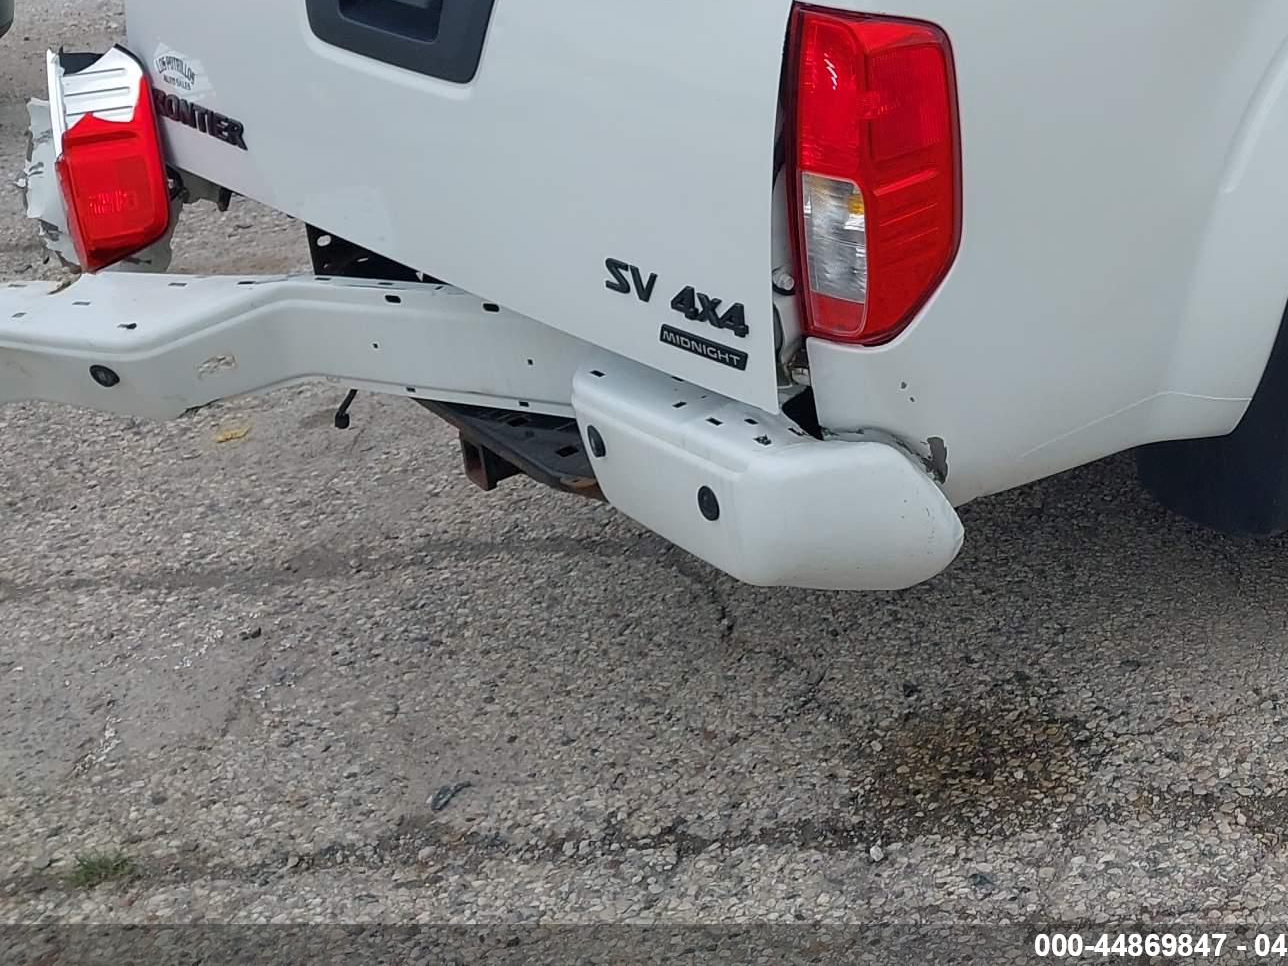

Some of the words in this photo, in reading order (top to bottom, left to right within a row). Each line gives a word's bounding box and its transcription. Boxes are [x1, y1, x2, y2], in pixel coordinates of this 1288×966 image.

[155, 56, 167, 74] LOS
[151, 88, 248, 151] RONTIER
[605, 257, 658, 303] SV
[662, 330, 741, 366] MIDNIGHT
